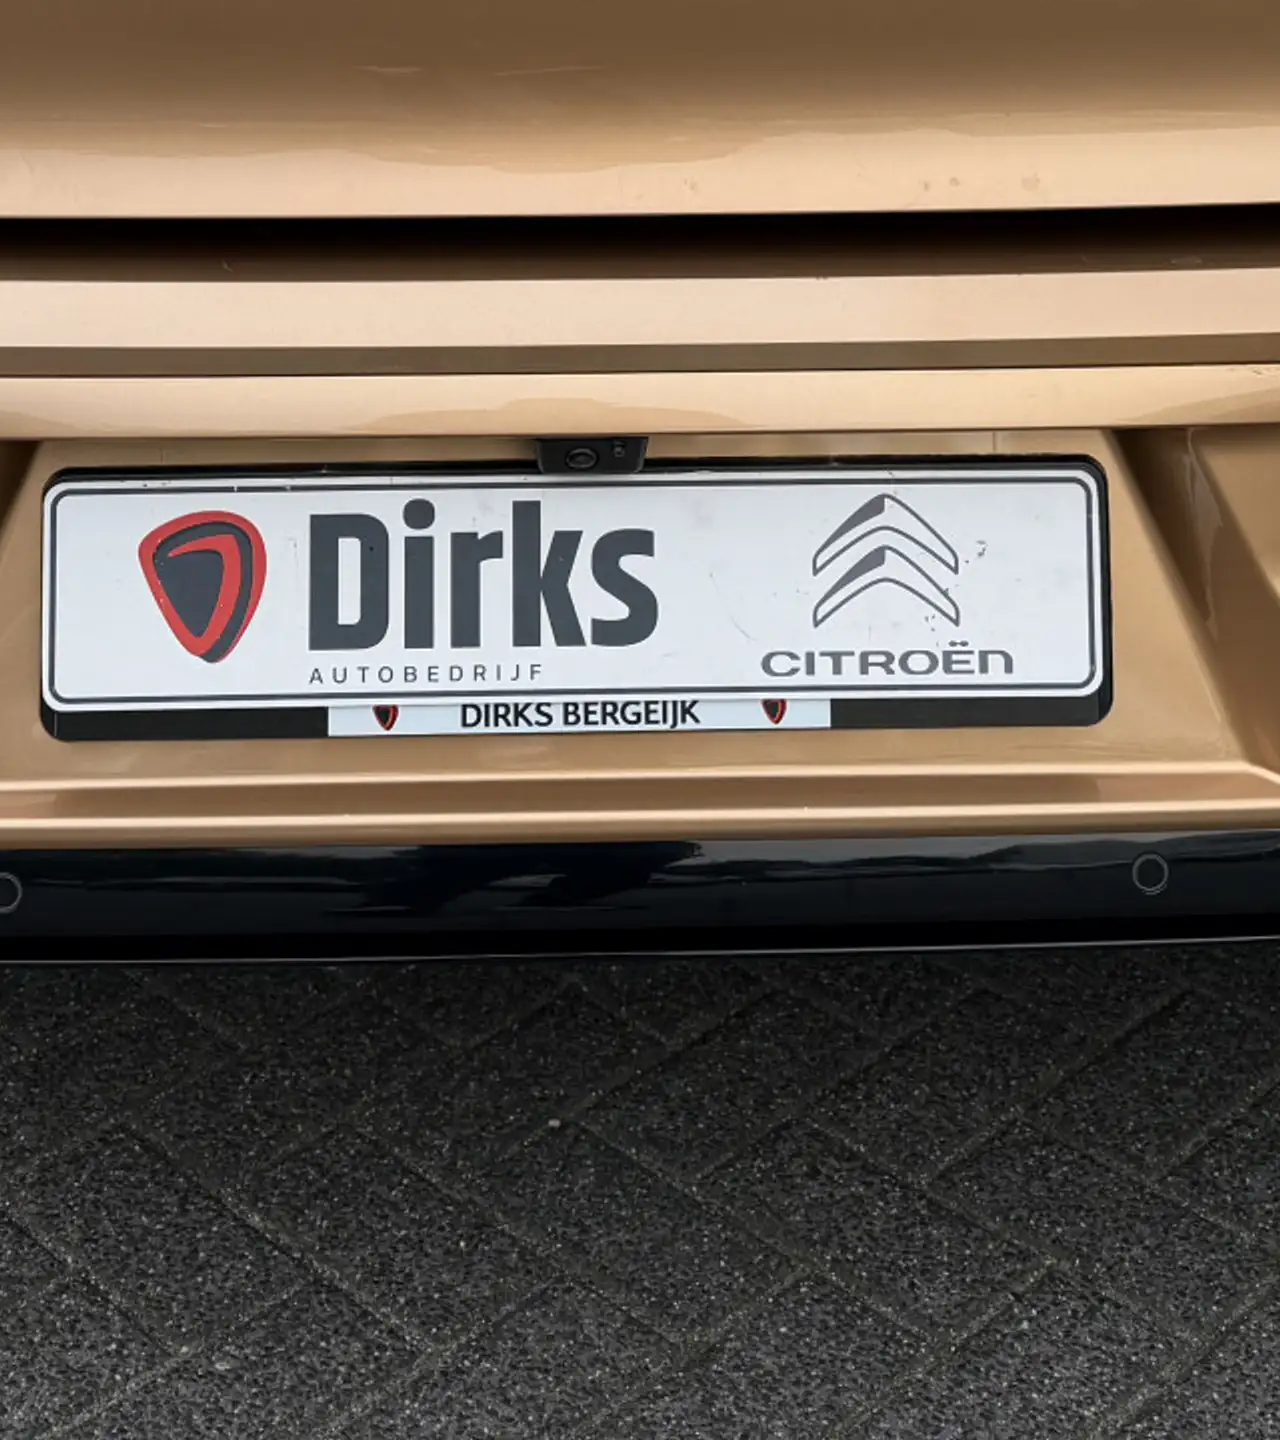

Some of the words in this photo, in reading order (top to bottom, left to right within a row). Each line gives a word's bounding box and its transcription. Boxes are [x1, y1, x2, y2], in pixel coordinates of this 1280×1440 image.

[308, 498, 659, 651] Dirks
[309, 663, 542, 685] AUTOBEDRIJF
[460, 702, 554, 729] DIRKS
[562, 699, 701, 728] BERGEIJK
